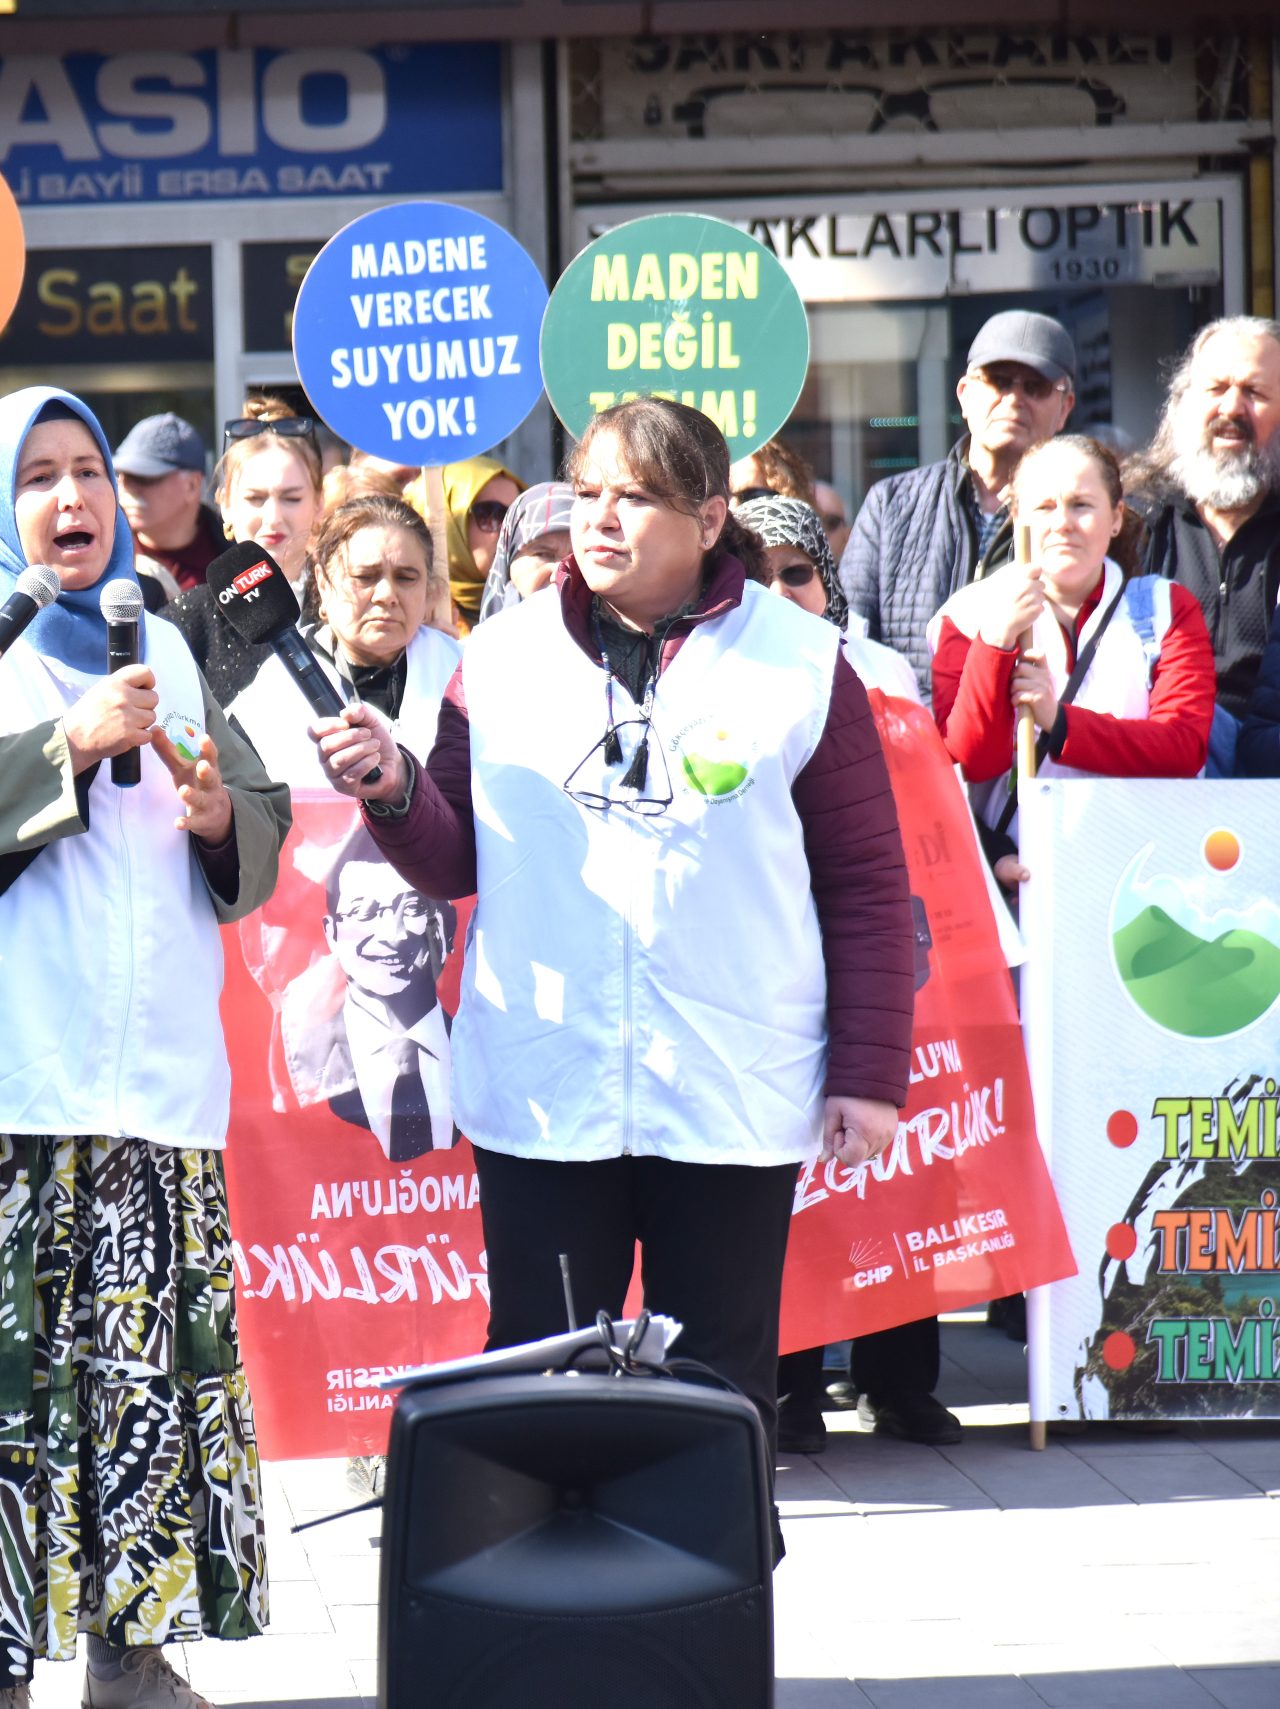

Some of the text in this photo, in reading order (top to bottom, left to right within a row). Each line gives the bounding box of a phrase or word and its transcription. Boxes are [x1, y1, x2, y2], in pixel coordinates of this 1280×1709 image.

[157, 169, 270, 197] ERSA
[277, 164, 392, 191] SAAT
[350, 234, 488, 280] MADENE
[590, 251, 759, 302] MADEN
[1051, 258, 1120, 283] 1930
[36, 267, 199, 337] Saat
[349, 284, 493, 329] VERECEK
[330, 335, 522, 389] SUYUMUZ
[606, 310, 741, 371] DEĞİL
[382, 396, 478, 441] YOK!
[588, 389, 758, 439] TM!
[242, 587, 260, 603] TV
[1151, 1077, 1280, 1162] TEMİ
[905, 1208, 1008, 1252] BALIKESİR
[912, 1230, 1016, 1273] İL BAŞKANLIĞI
[1150, 1188, 1280, 1275] TEMİ
[852, 1264, 894, 1289] CHP
[1145, 1297, 1280, 1385] TEMİ
